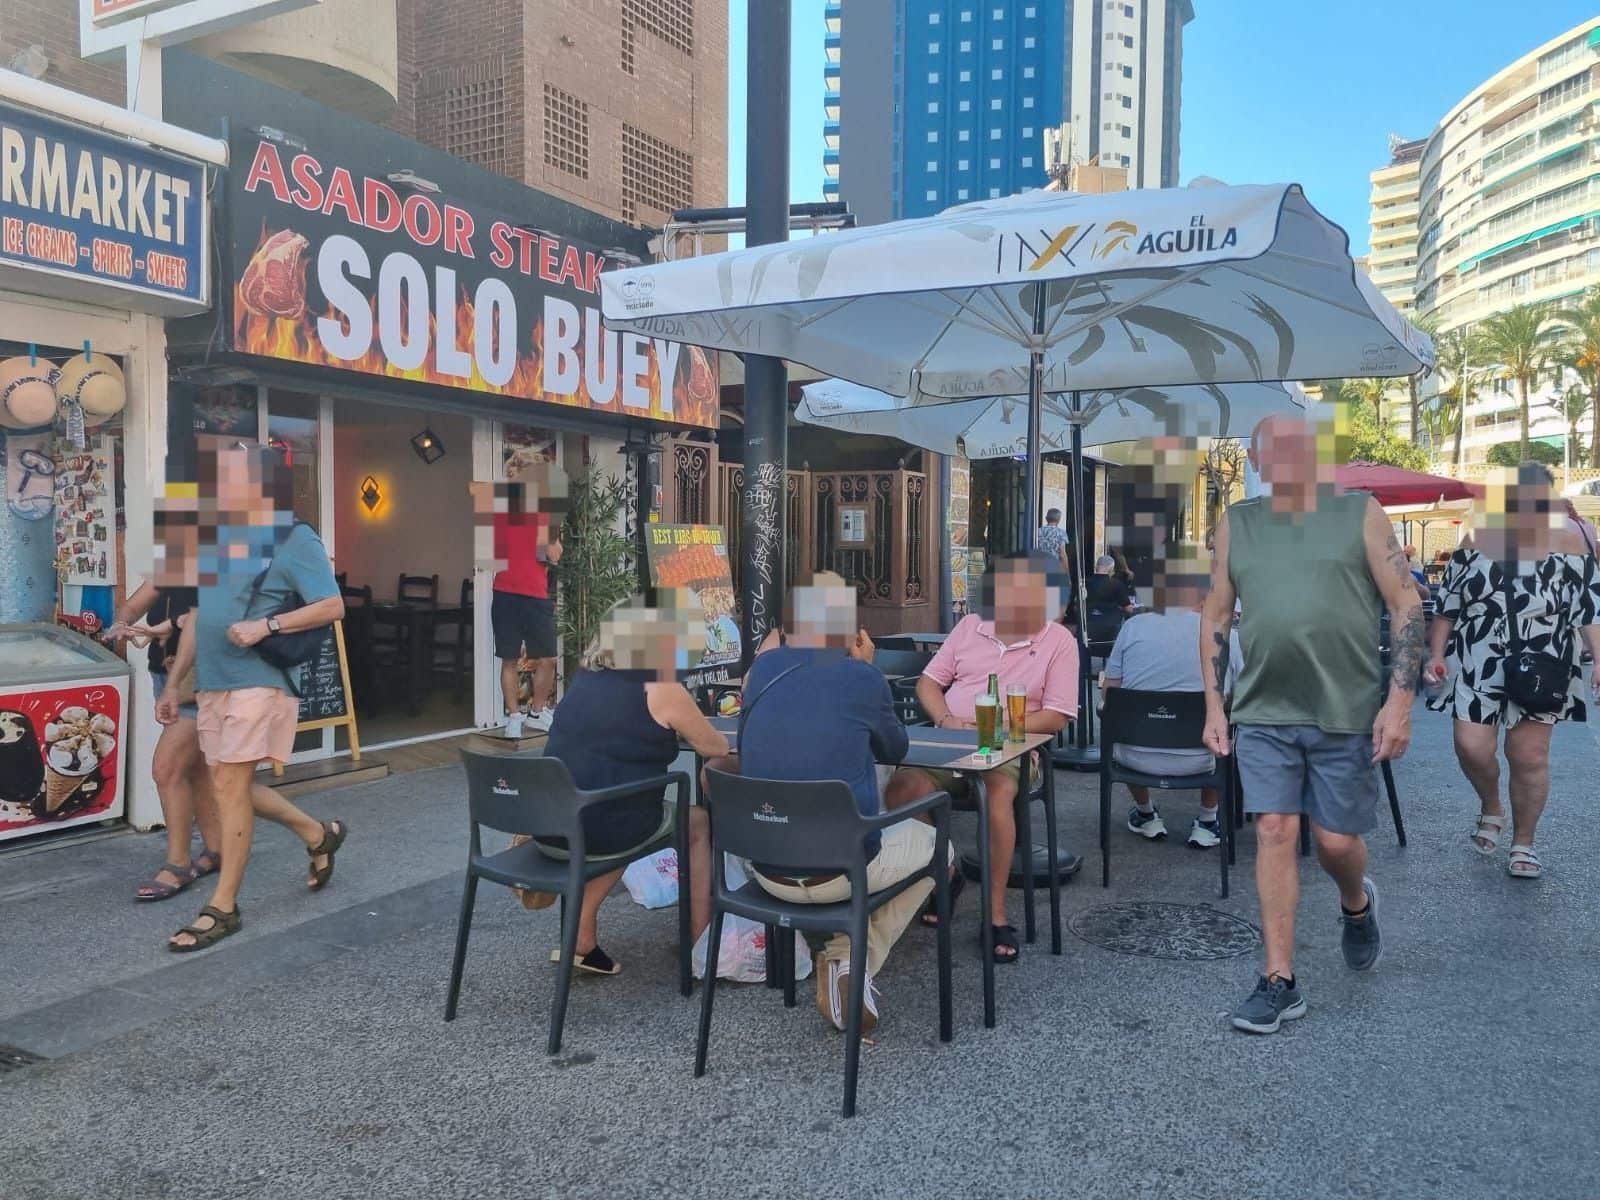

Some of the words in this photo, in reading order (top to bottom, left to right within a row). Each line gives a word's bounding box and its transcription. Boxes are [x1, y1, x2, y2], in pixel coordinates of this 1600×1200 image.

[2, 127, 190, 246] RMARKET
[245, 141, 474, 259] ASADOR
[489, 222, 605, 295] STEAK
[1190, 214, 1206, 227] EL
[3, 217, 23, 255] ICE
[26, 222, 77, 267] CREAMS
[92, 237, 133, 279] SPIRITS
[147, 250, 187, 290] SWEETS
[1137, 227, 1237, 255] AGUILA
[316, 234, 518, 387] SOLO
[544, 295, 681, 414] BUEY
[653, 528, 672, 545] BEST
